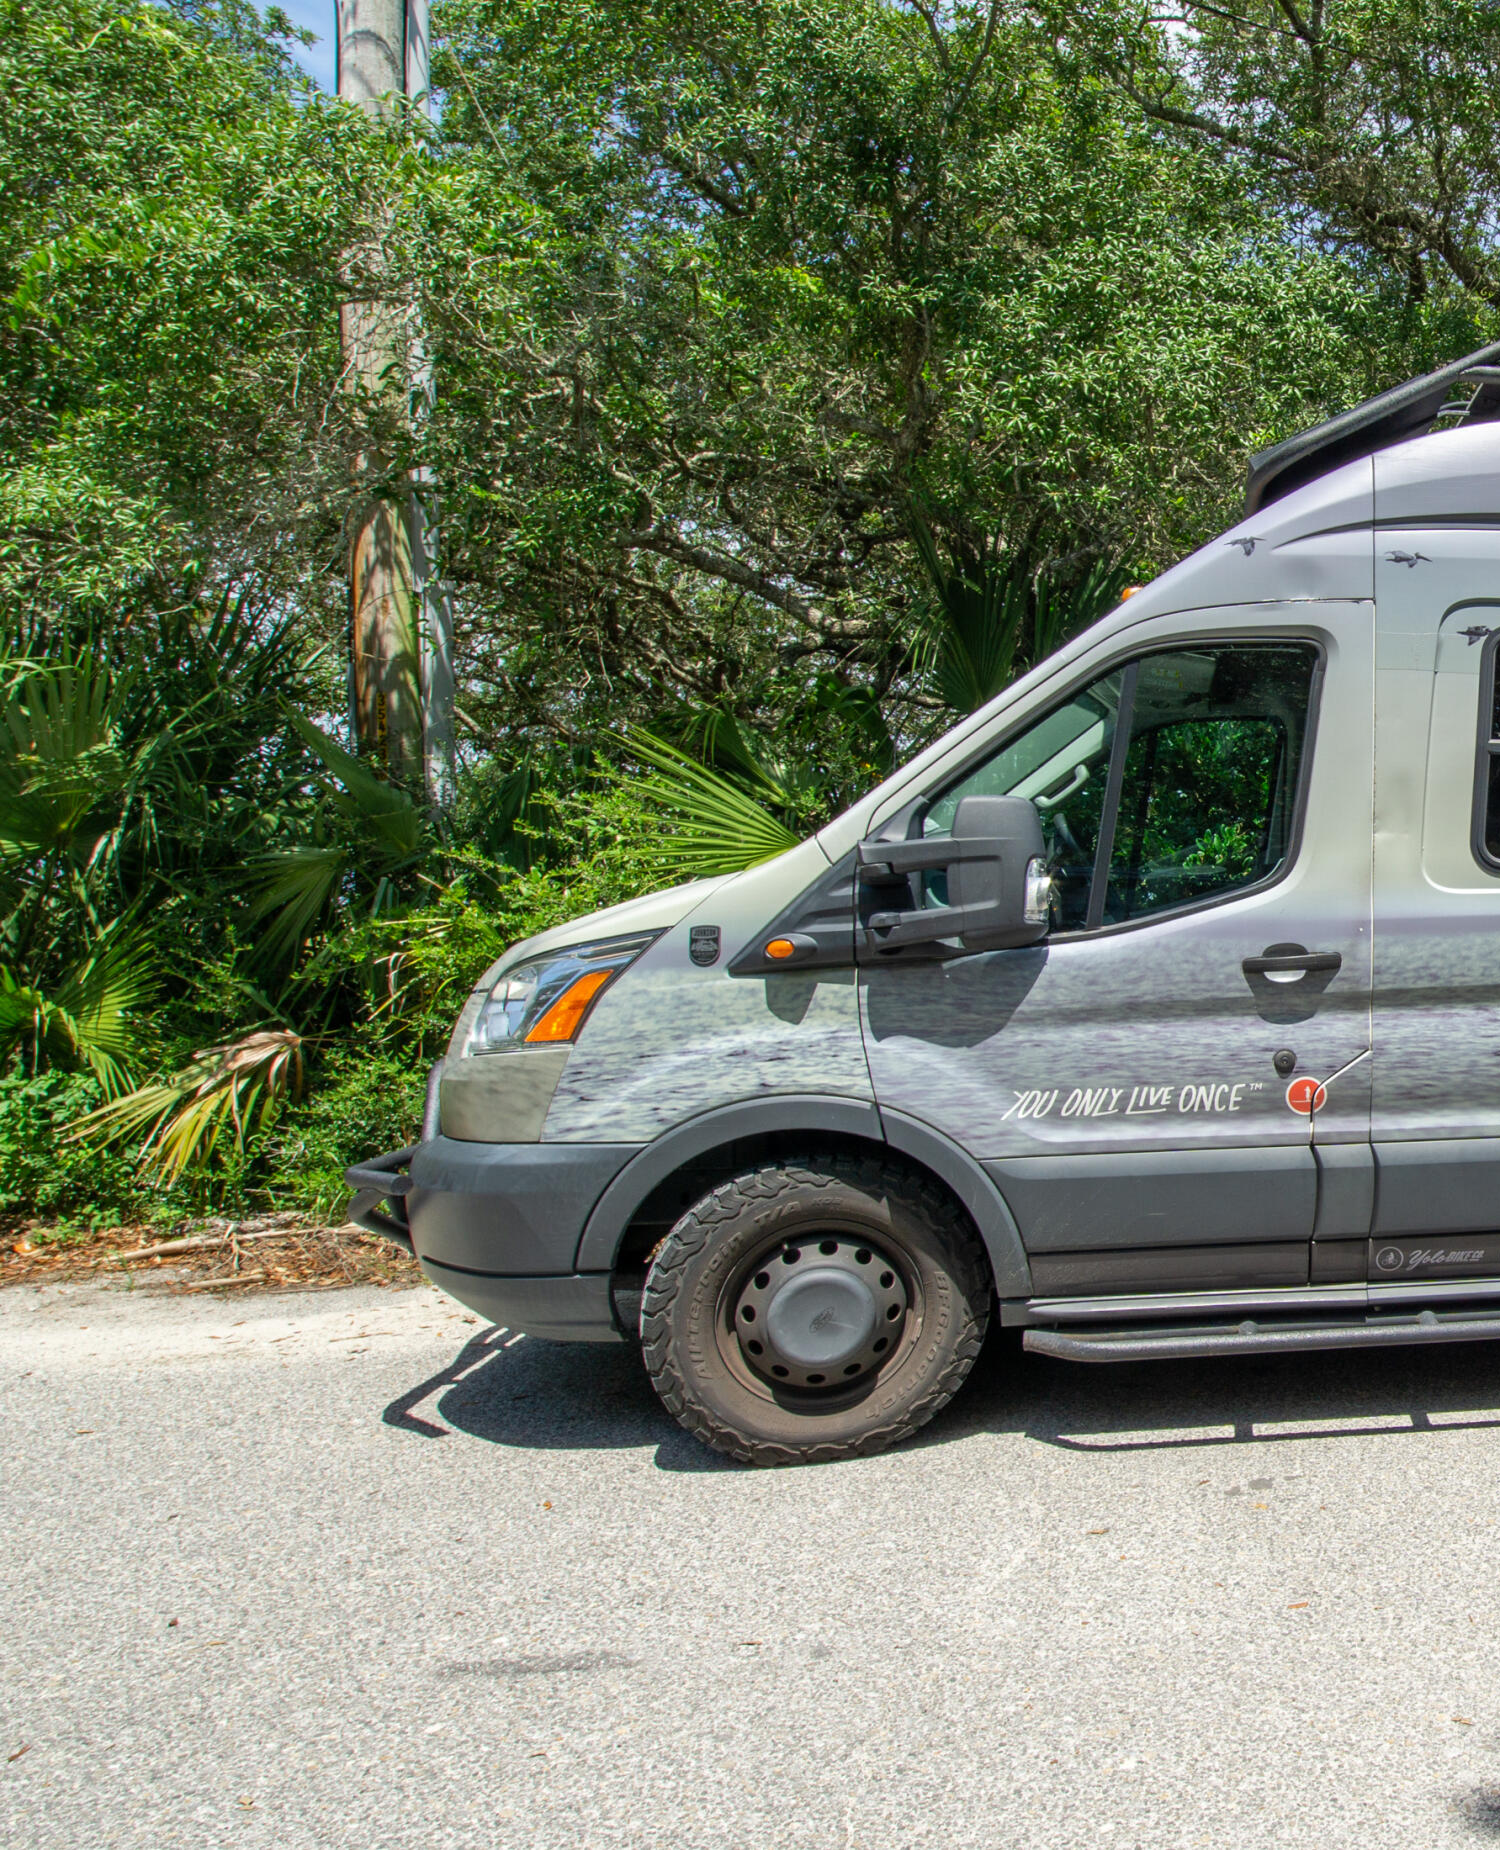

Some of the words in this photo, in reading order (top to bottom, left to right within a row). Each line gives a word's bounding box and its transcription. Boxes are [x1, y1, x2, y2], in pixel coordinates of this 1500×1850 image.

[1001, 1089, 1059, 1121] YOU
[1060, 1087, 1124, 1118] ONLY
[1125, 1086, 1175, 1115] LIVE
[1178, 1083, 1247, 1112] ONCE
